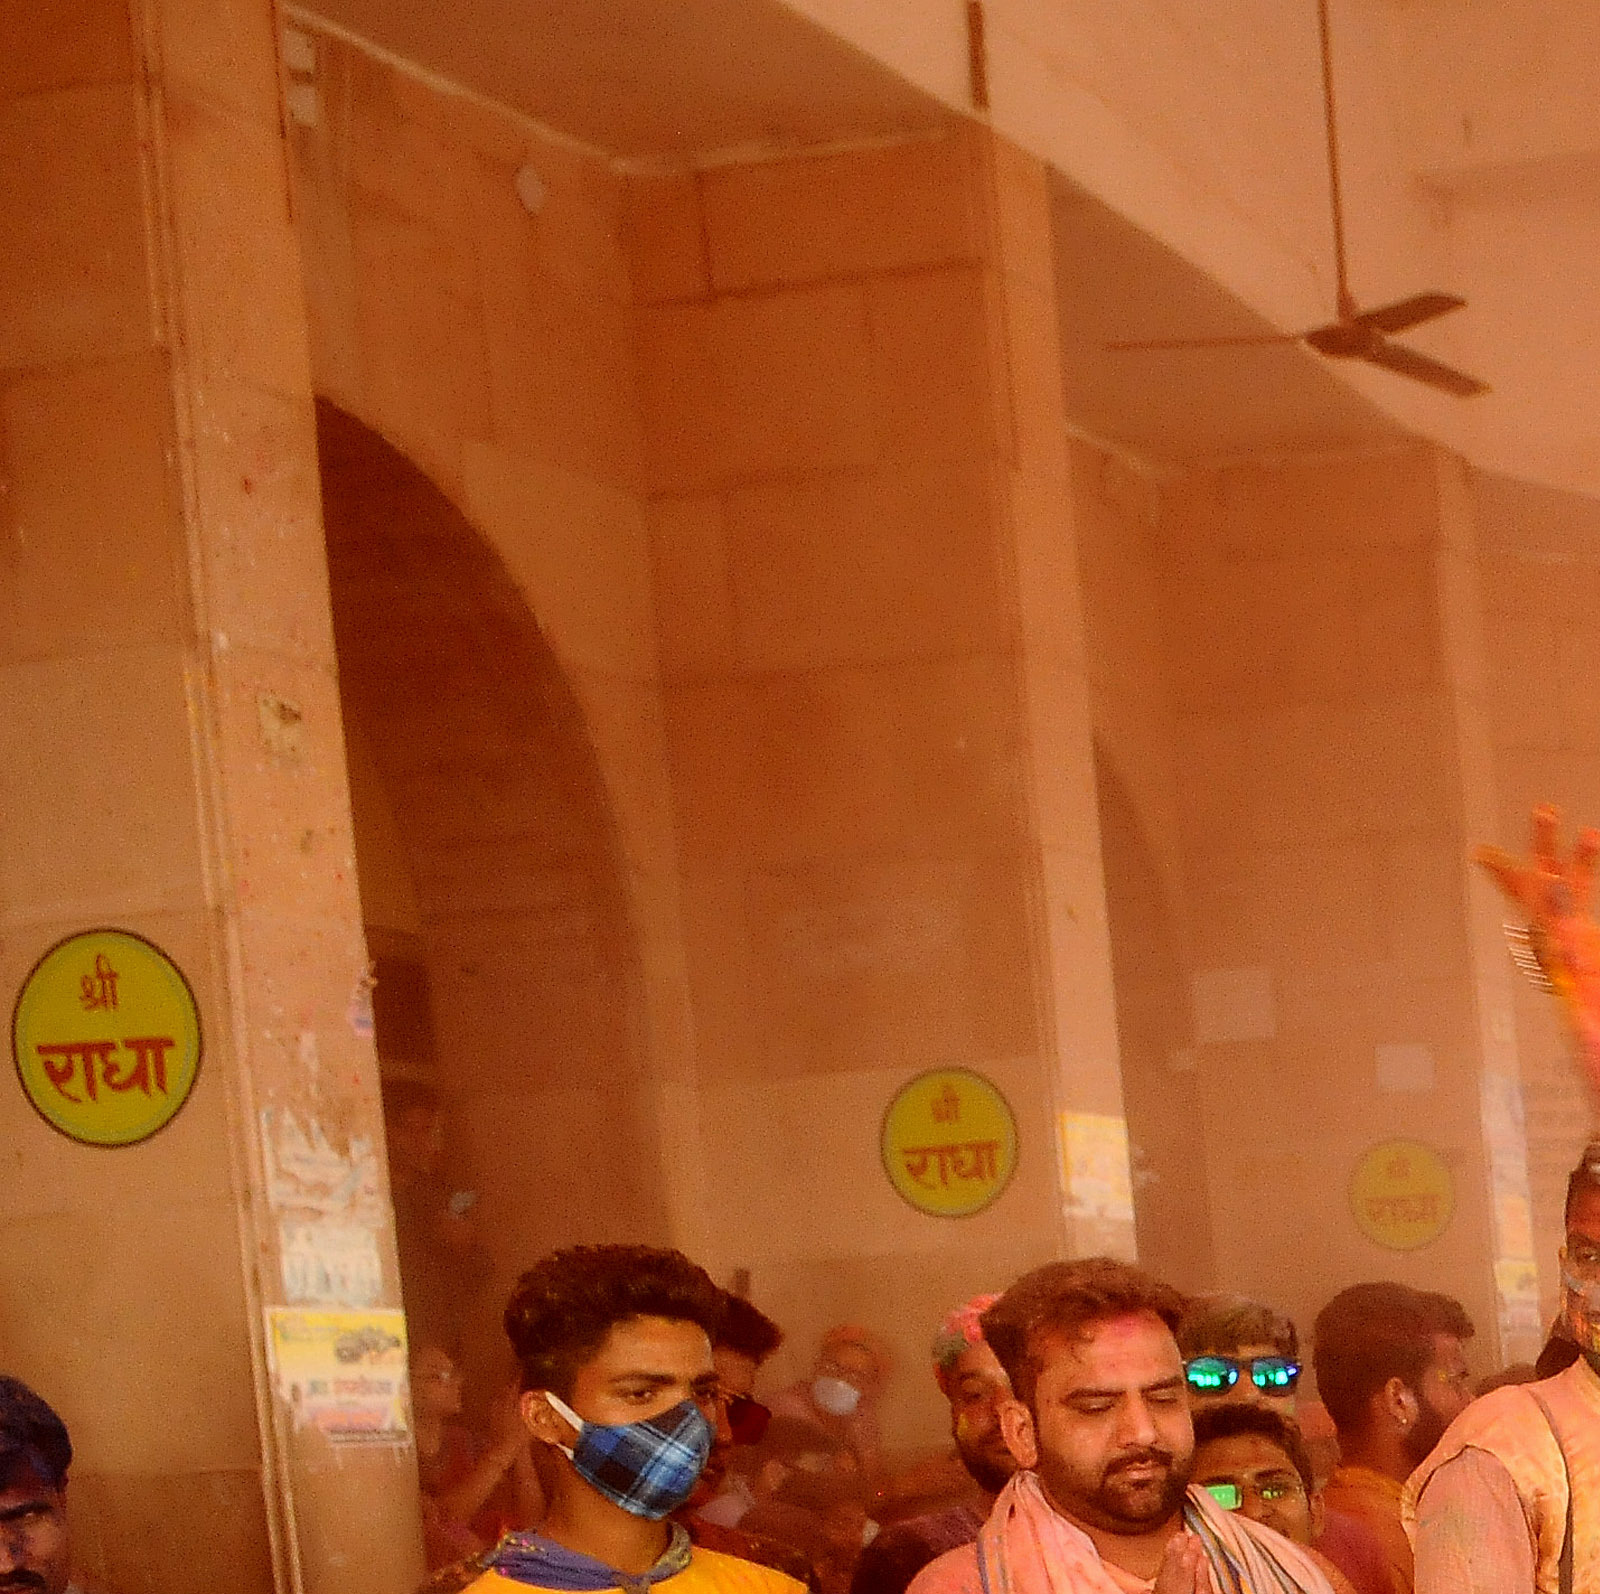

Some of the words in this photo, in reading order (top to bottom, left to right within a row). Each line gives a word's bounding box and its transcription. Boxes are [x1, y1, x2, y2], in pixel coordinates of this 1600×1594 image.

[79, 953, 119, 1012] श्री
[36, 1037, 176, 1104] राधा
[901, 1139, 999, 1190] राधा
